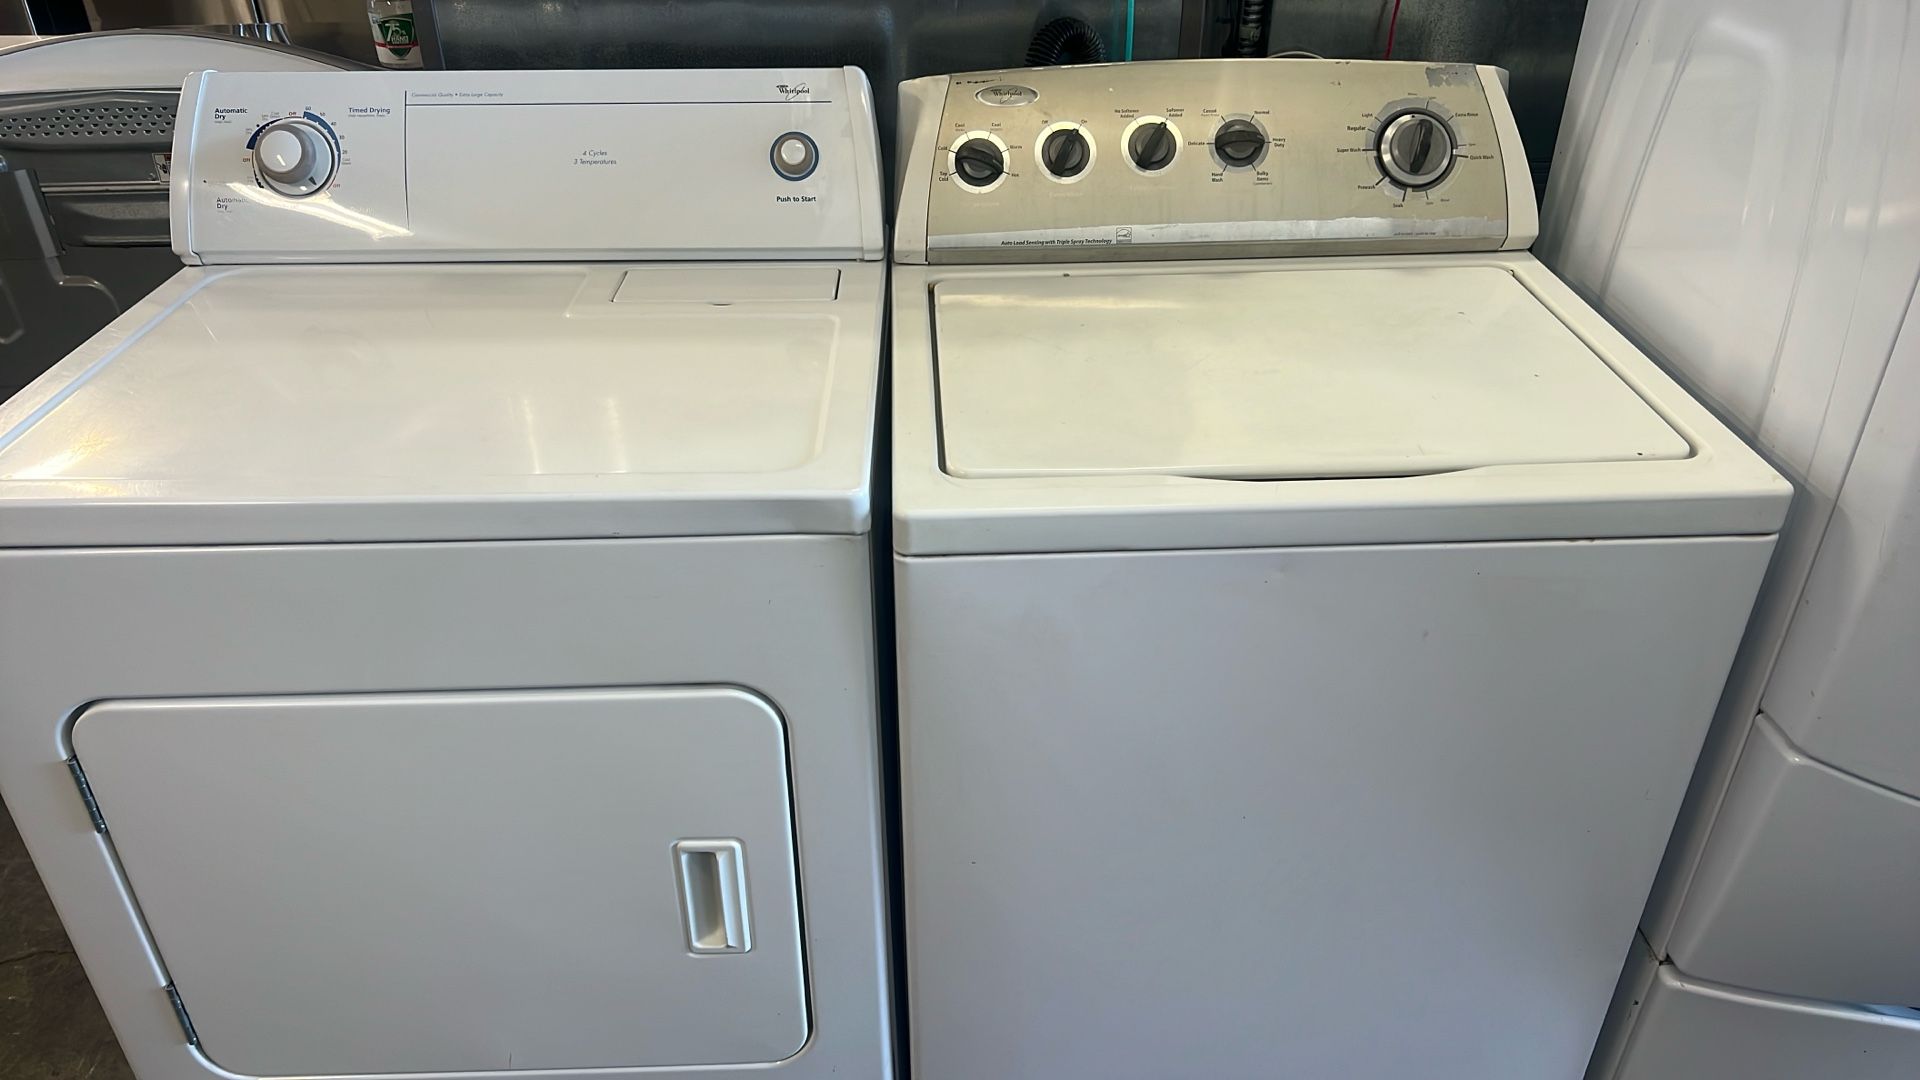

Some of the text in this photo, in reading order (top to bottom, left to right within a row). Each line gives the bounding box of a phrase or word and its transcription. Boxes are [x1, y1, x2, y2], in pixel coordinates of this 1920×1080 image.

[776, 84, 810, 97] Whirlpool
[990, 88, 1022, 100] Whirlpool
[588, 149, 608, 157] Cycles
[580, 158, 617, 166] Temperatures
